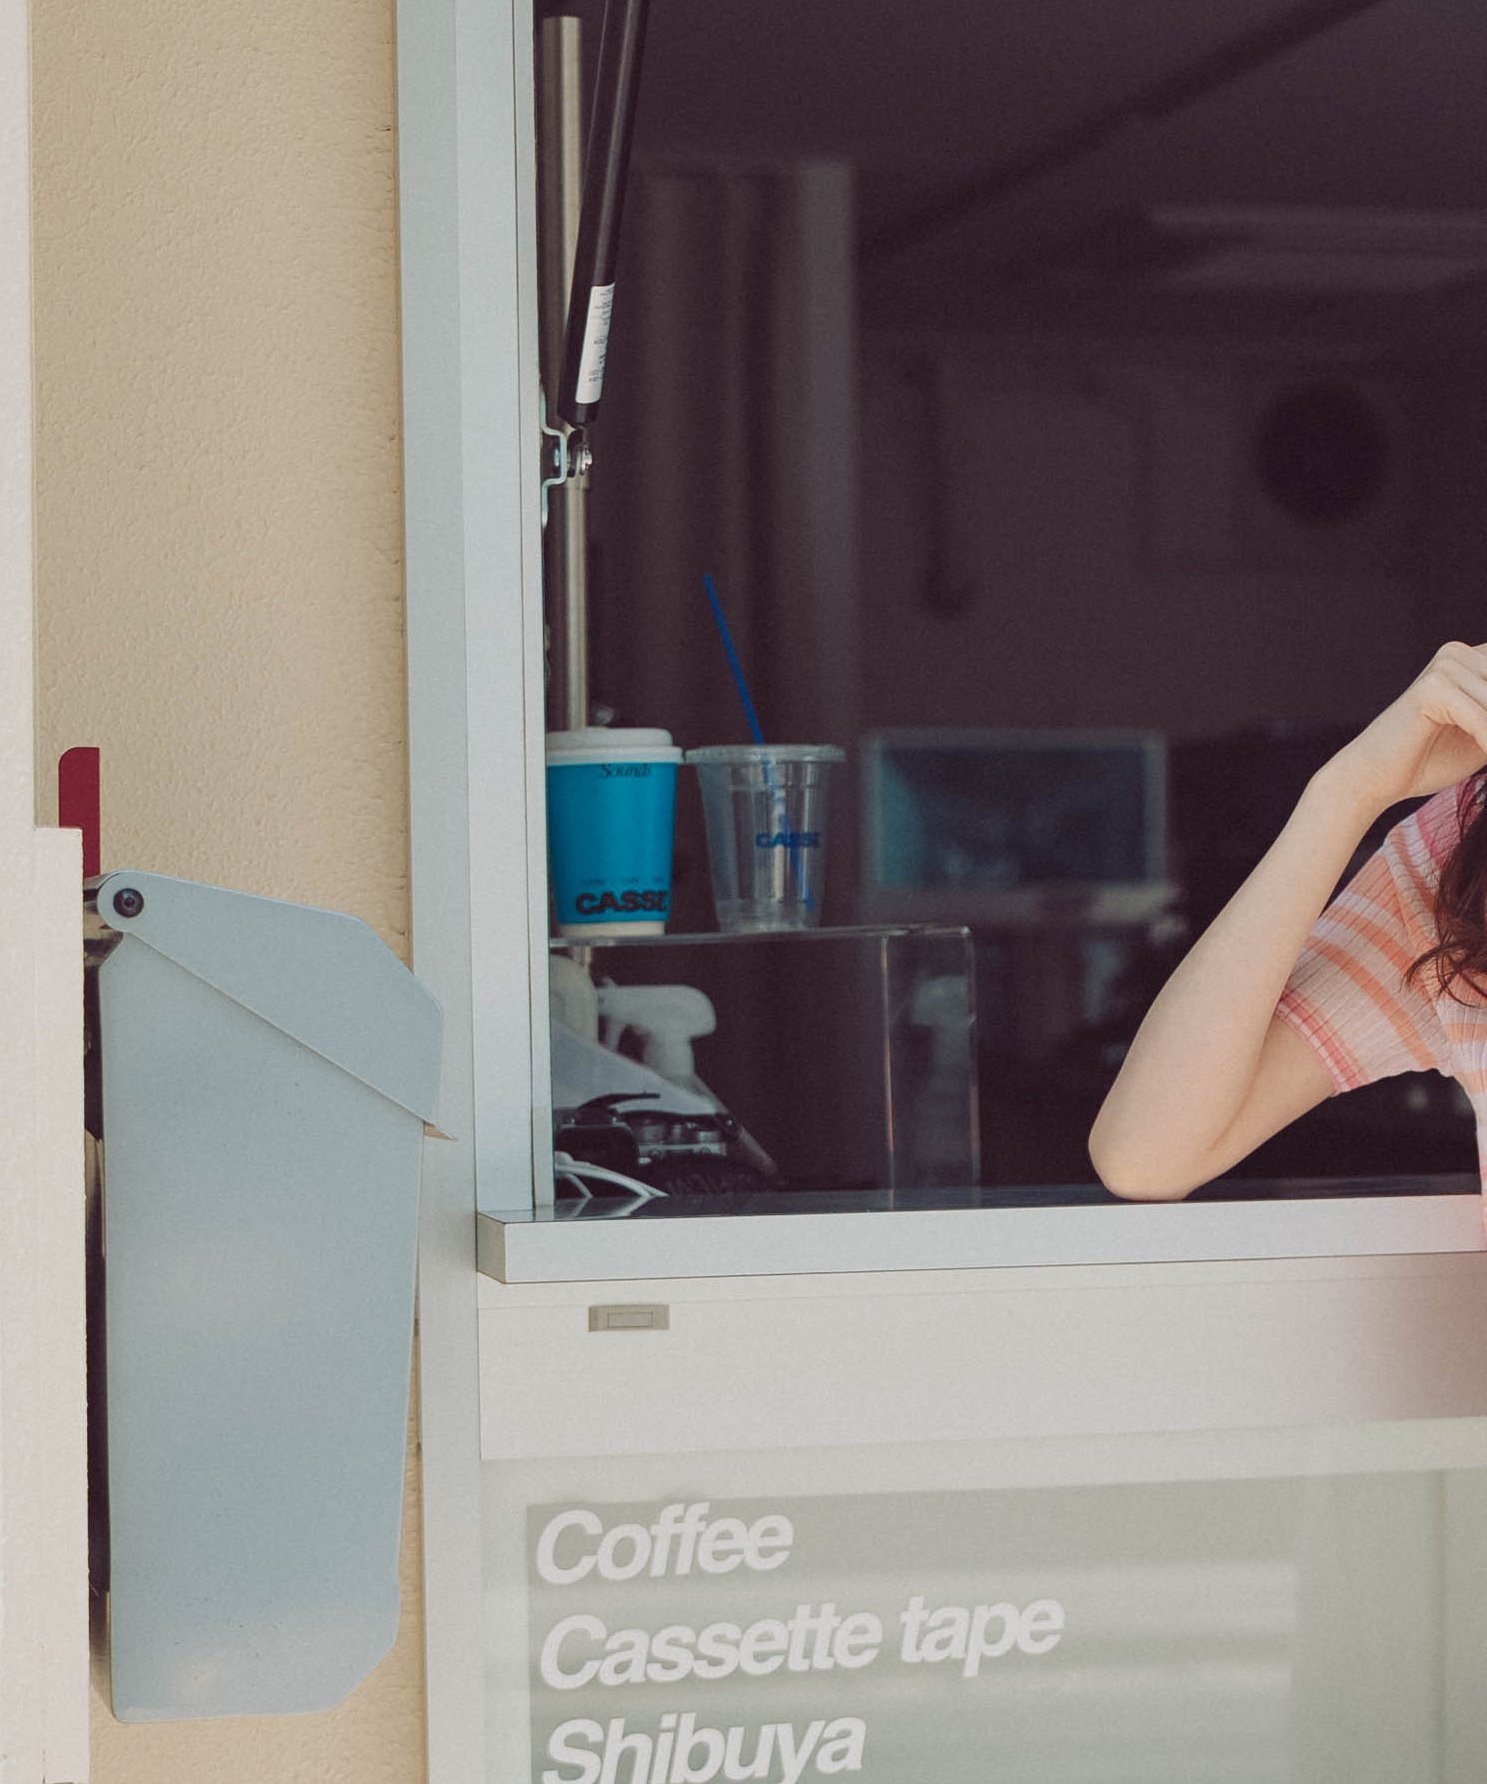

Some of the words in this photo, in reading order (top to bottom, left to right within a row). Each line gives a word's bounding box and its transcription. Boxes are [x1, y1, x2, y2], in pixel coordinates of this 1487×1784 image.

[536, 1501, 795, 1585] Coffee
[540, 1602, 884, 1690] Cassette
[900, 1596, 1067, 1678] tape
